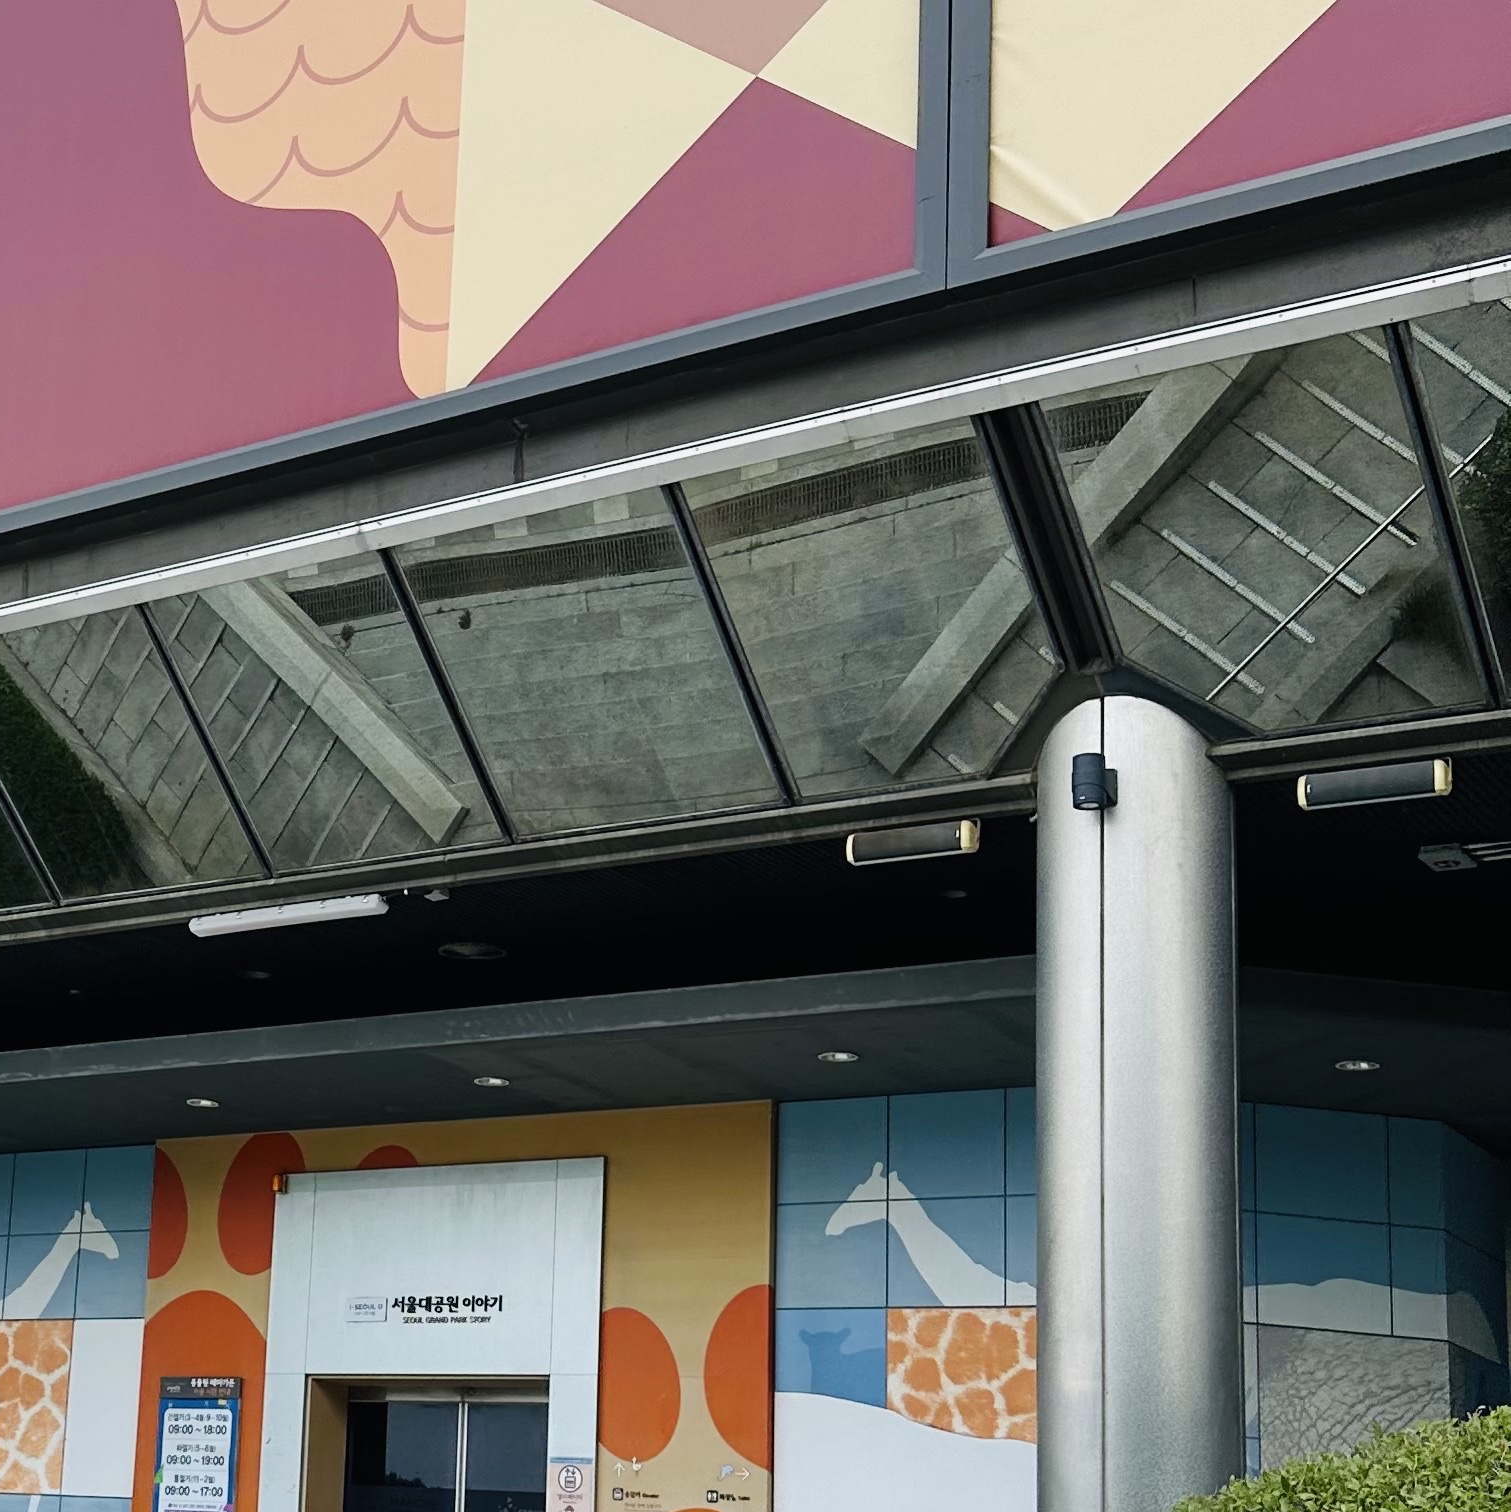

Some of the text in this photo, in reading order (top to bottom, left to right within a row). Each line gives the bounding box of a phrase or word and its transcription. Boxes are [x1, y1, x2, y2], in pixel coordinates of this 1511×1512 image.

[391, 1294, 503, 1313] 서울대공원 이야기
[402, 1316, 491, 1324] SEOUL GRAND PARK STORY
[168, 1424, 194, 1434] 09:00
[203, 1424, 227, 1434] 18:00
[166, 1454, 192, 1465] 09:00
[201, 1455, 225, 1466] 19:00
[164, 1485, 190, 1496] 09:00
[200, 1486, 223, 1497] 17:00
